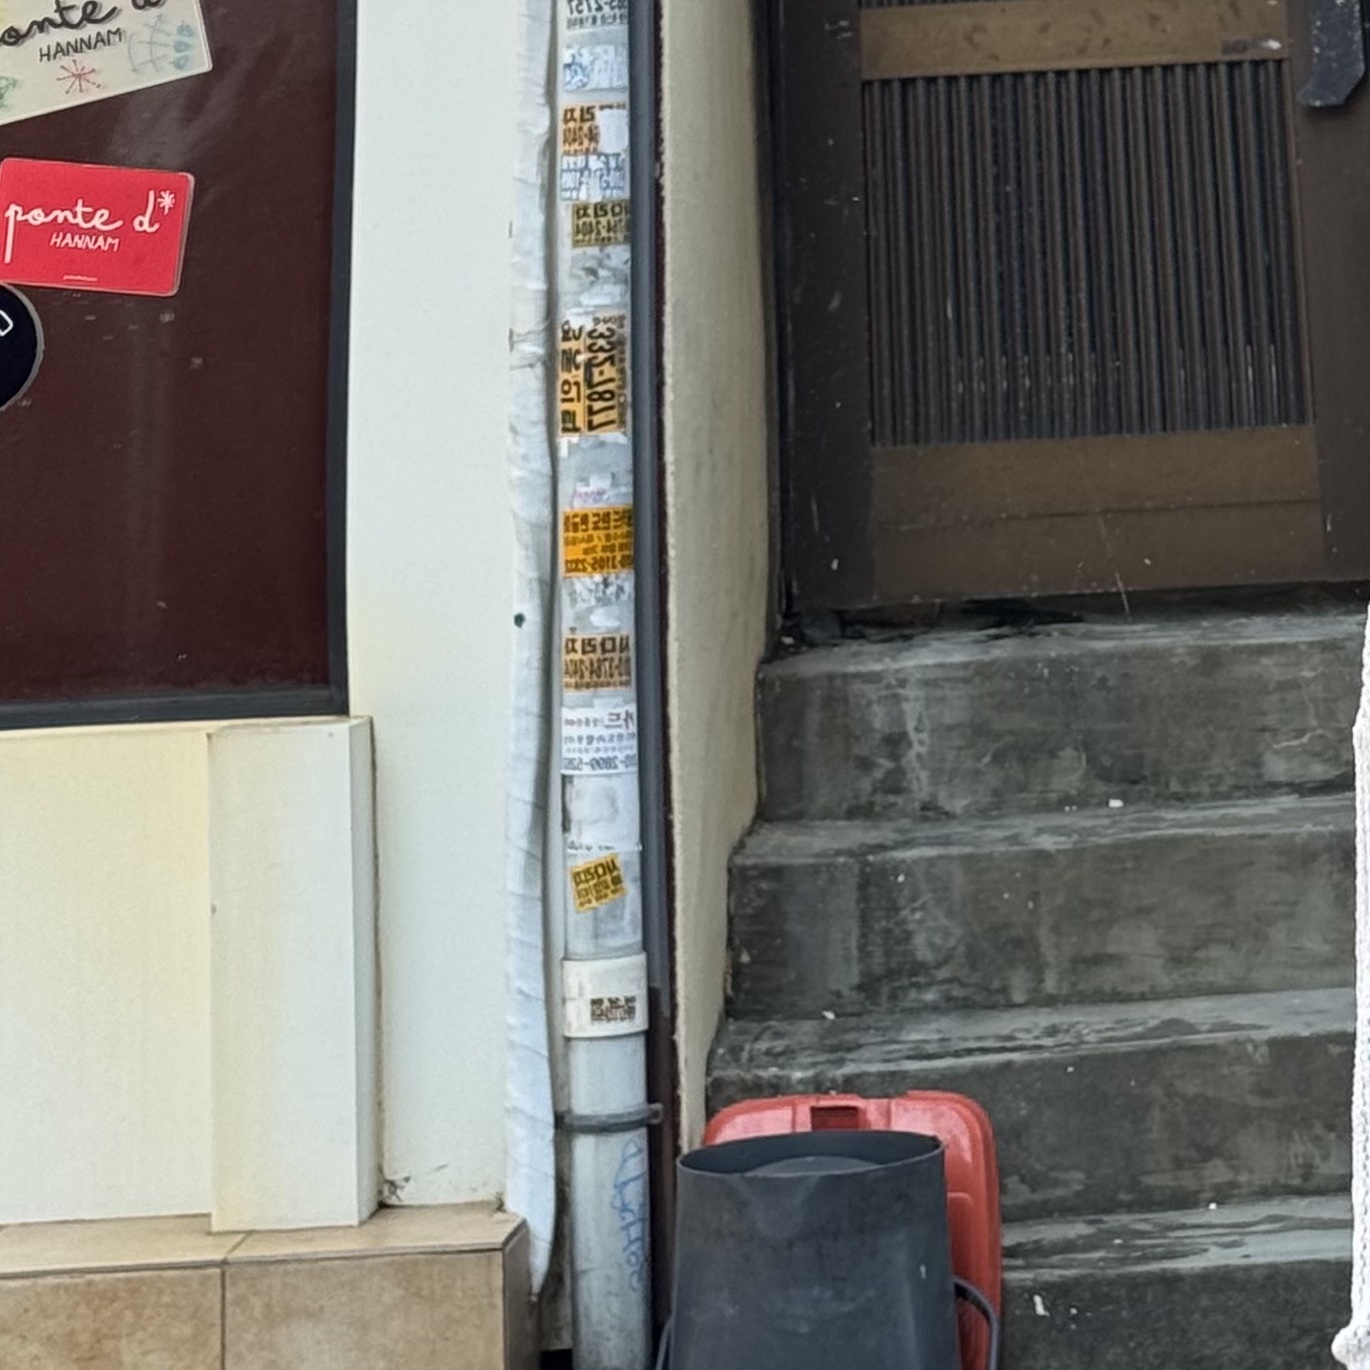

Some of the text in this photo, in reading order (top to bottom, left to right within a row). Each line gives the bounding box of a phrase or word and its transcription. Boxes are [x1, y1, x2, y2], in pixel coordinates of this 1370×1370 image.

[0, 0, 118, 46] onte
[38, 28, 123, 63] HANNAM
[5, 199, 123, 263] ponte
[50, 231, 121, 252] HANNAM
